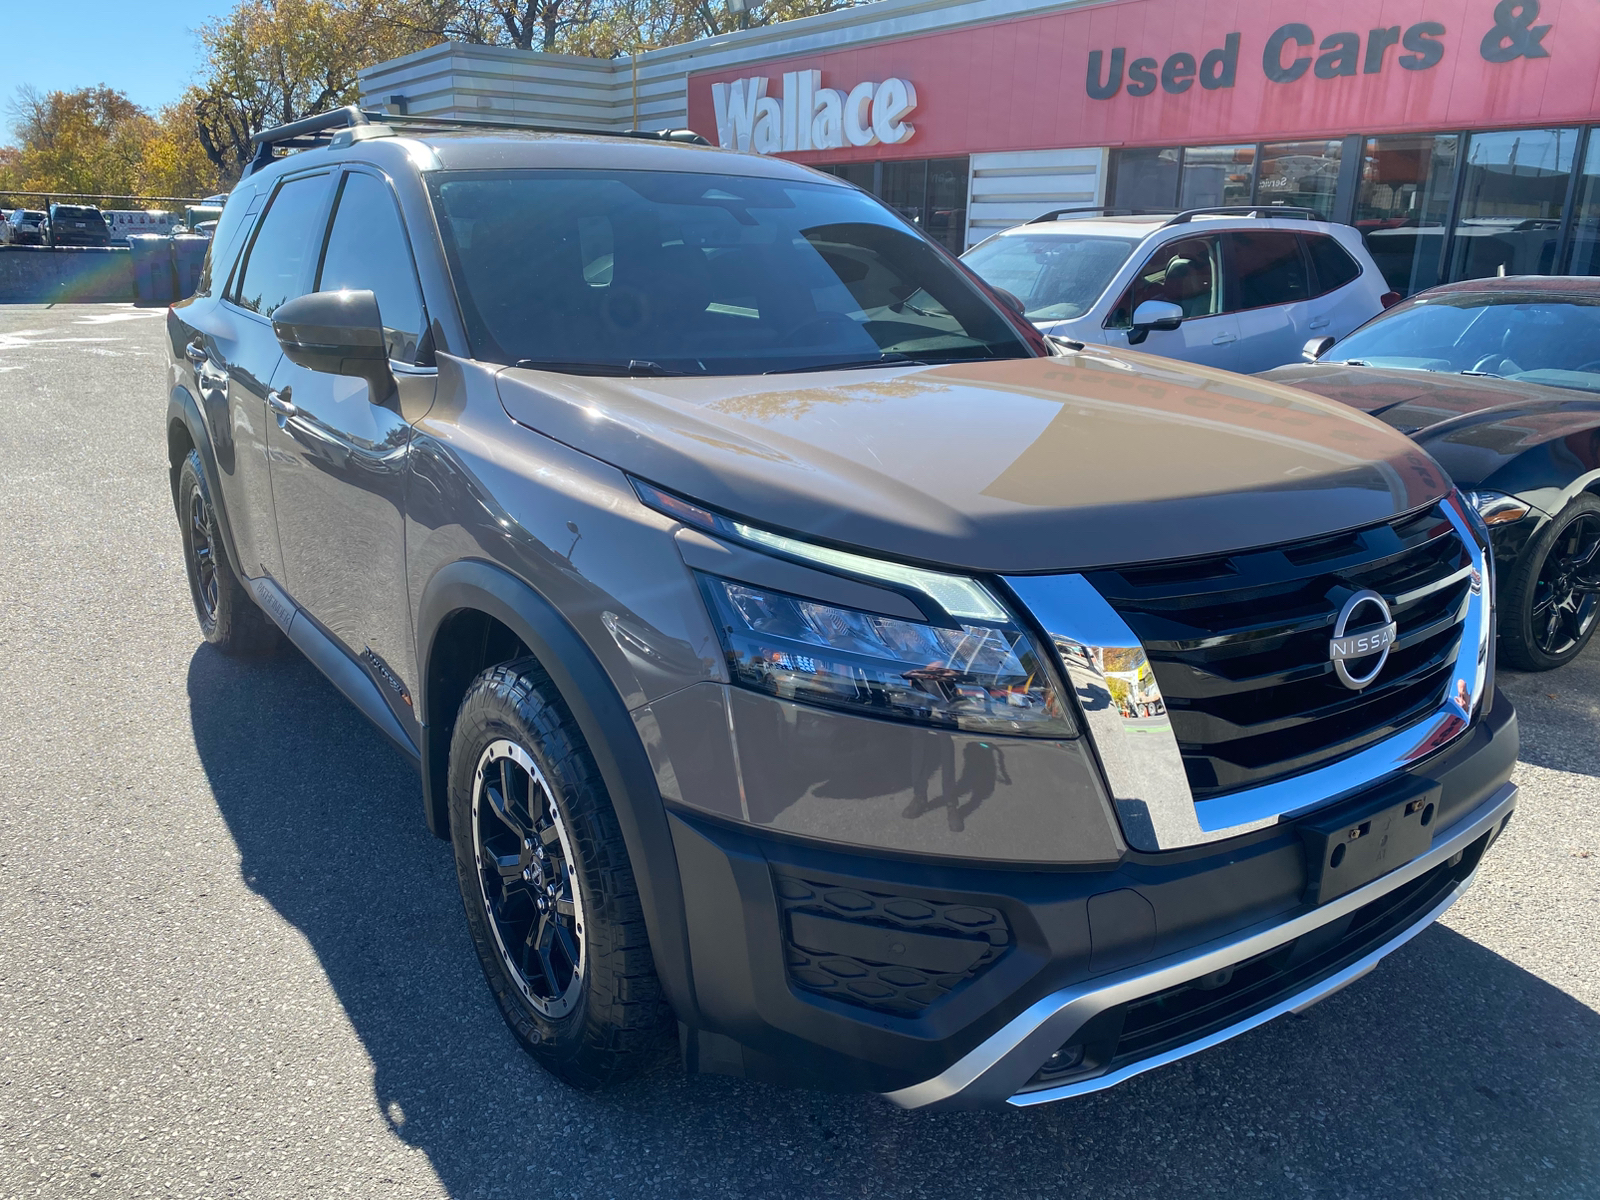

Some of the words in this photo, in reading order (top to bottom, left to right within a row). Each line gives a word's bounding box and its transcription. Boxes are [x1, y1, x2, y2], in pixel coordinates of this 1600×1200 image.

[1086, 32, 1241, 100] Used
[1263, 21, 1446, 84] Cars
[1480, 0, 1552, 63] &
[711, 69, 917, 155] Wallace
[256, 581, 291, 625] PATHFINDER
[1333, 627, 1396, 657] NISSAN
